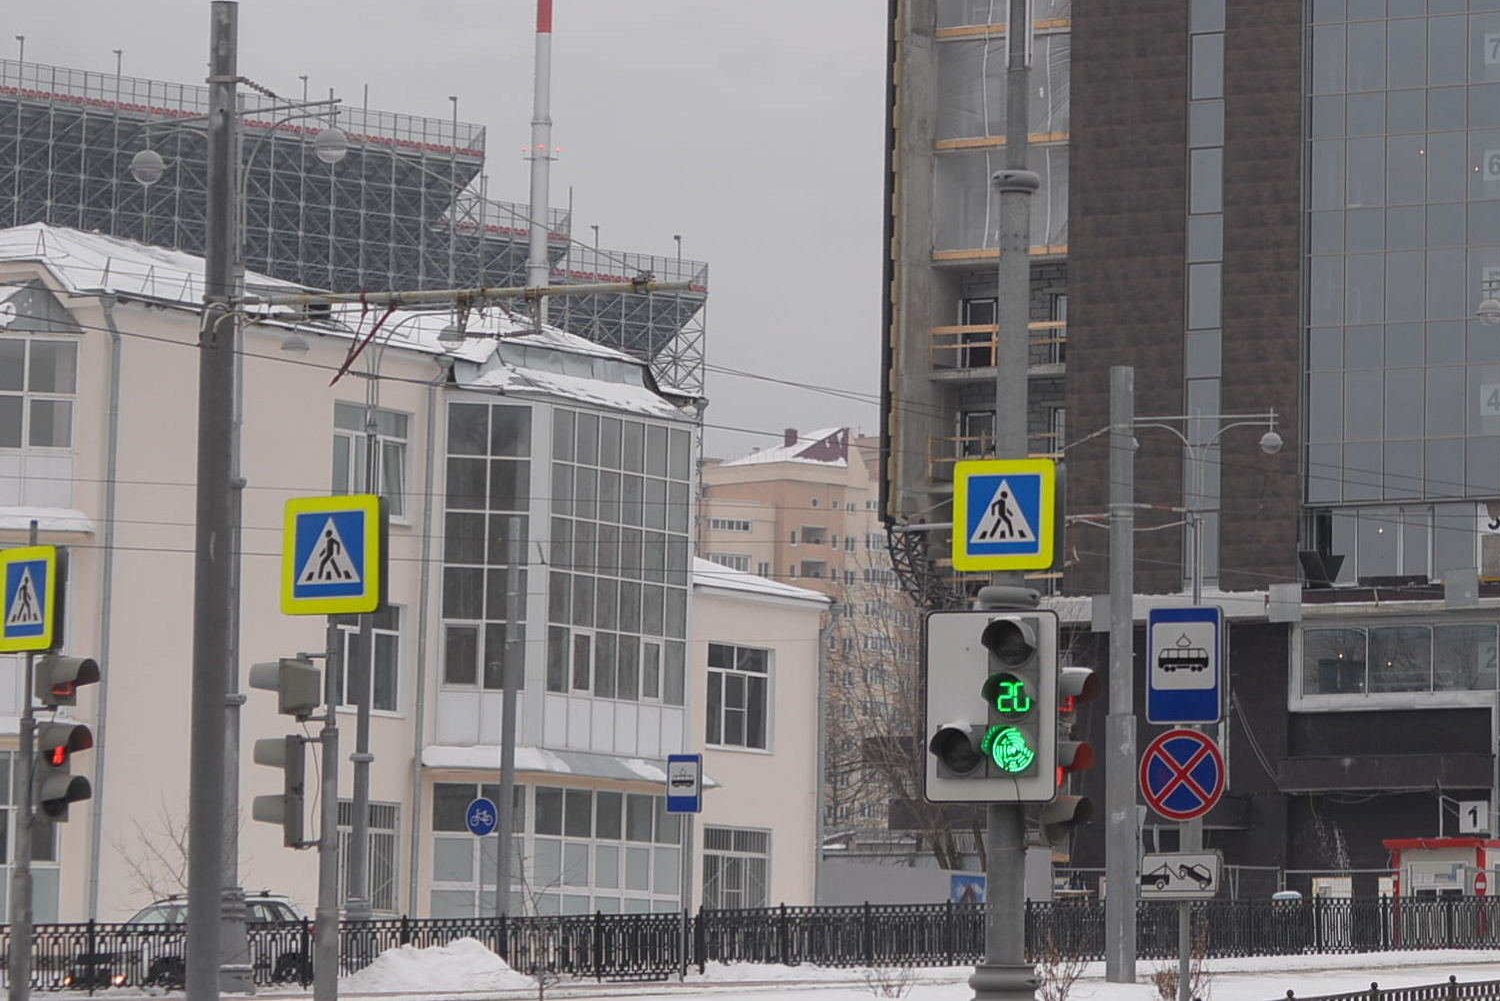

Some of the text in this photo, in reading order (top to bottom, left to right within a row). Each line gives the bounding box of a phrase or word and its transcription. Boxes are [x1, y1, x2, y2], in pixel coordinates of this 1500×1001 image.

[1487, 388, 1500, 411] 4
[1486, 646, 1498, 668] 2
[1468, 805, 1478, 828] 1
